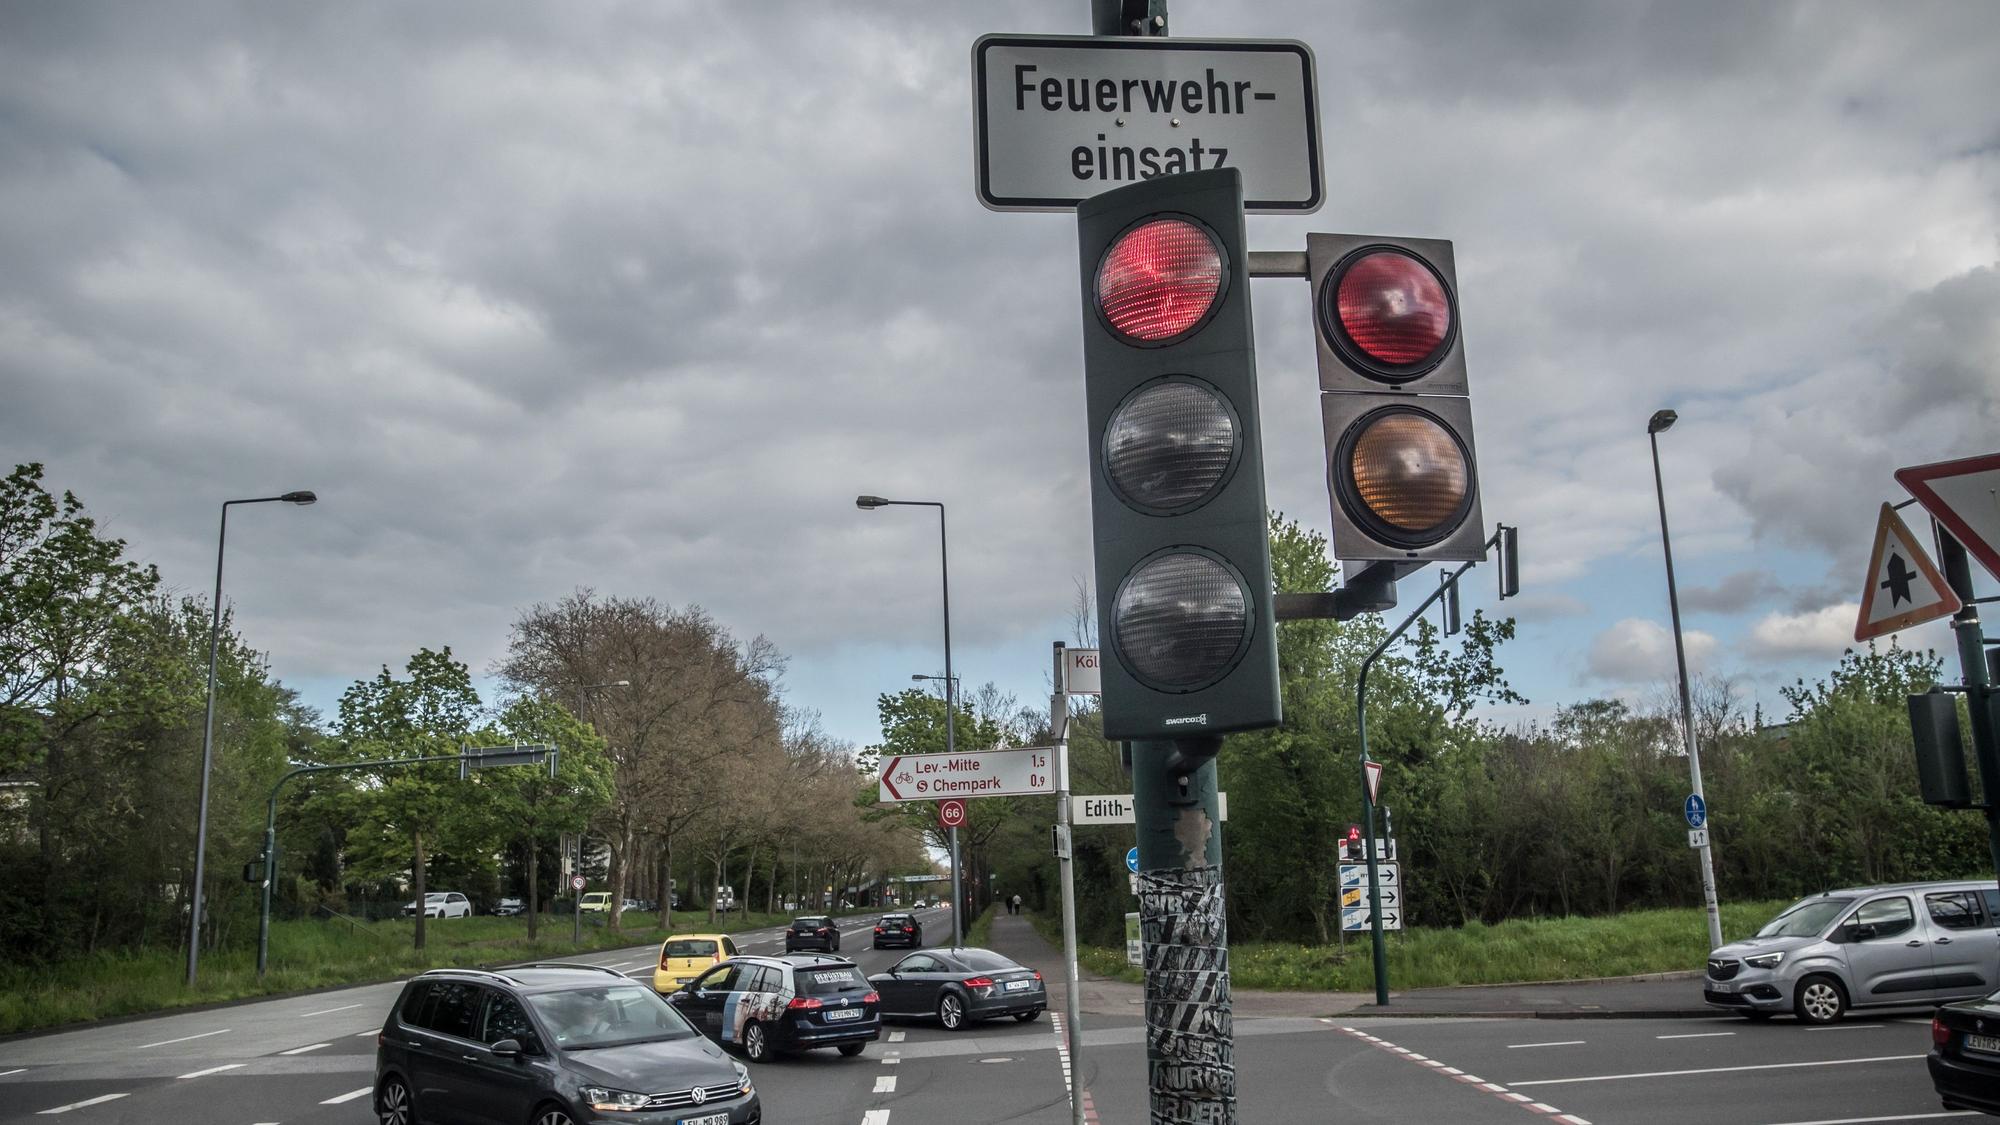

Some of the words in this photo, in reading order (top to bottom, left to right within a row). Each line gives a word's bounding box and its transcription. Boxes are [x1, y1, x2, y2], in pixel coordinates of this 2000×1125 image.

[1014, 64, 1276, 115] Feuerwehr-
[1071, 133, 1229, 181] einsatz
[1075, 655, 1099, 668] Köl
[916, 759, 980, 773] Lev.-Mitte
[933, 776, 1001, 793] Chempark
[945, 808, 960, 818] 66
[1085, 799, 1135, 817] Edith-
